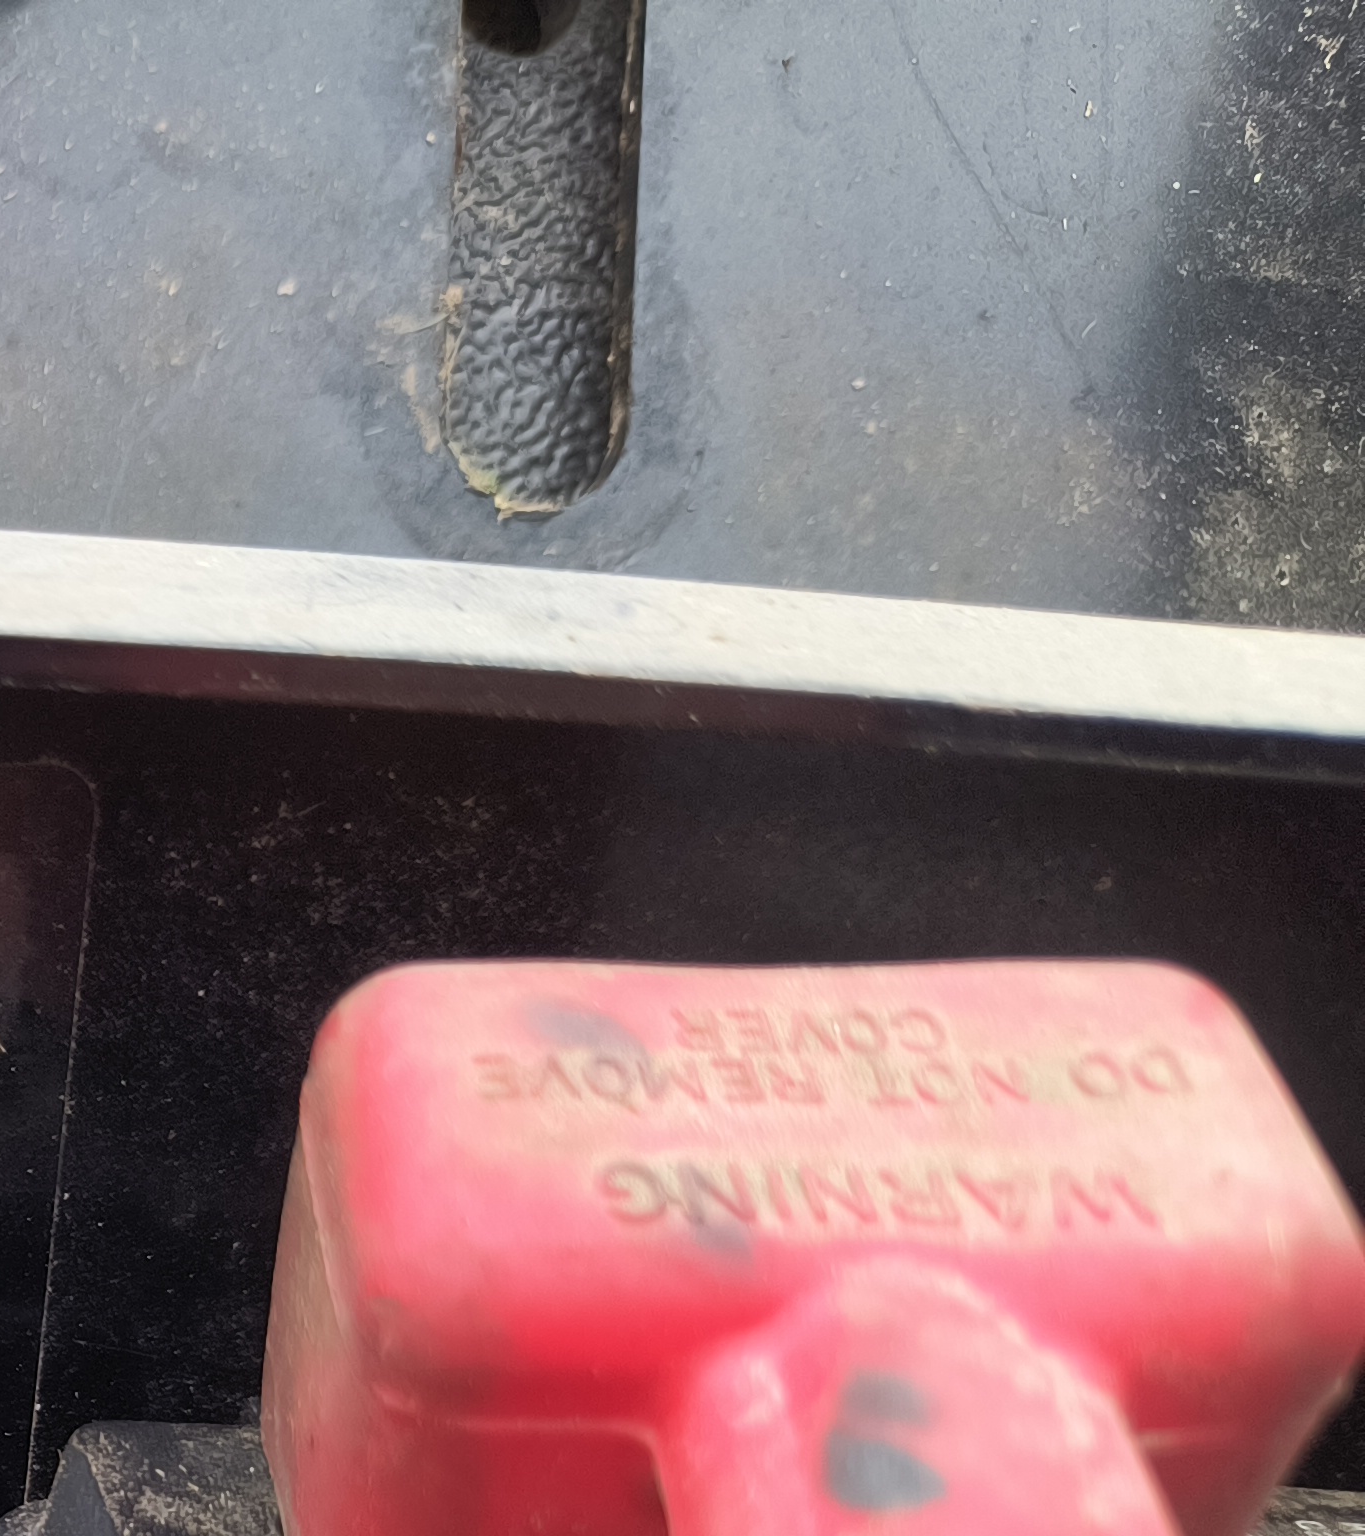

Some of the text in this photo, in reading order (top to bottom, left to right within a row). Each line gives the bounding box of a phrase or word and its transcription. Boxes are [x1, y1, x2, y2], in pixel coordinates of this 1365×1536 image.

[677, 1008, 947, 1054] COVER
[472, 1047, 1192, 1107] DO NOT REMOVE
[598, 1158, 1161, 1229] WARNING
